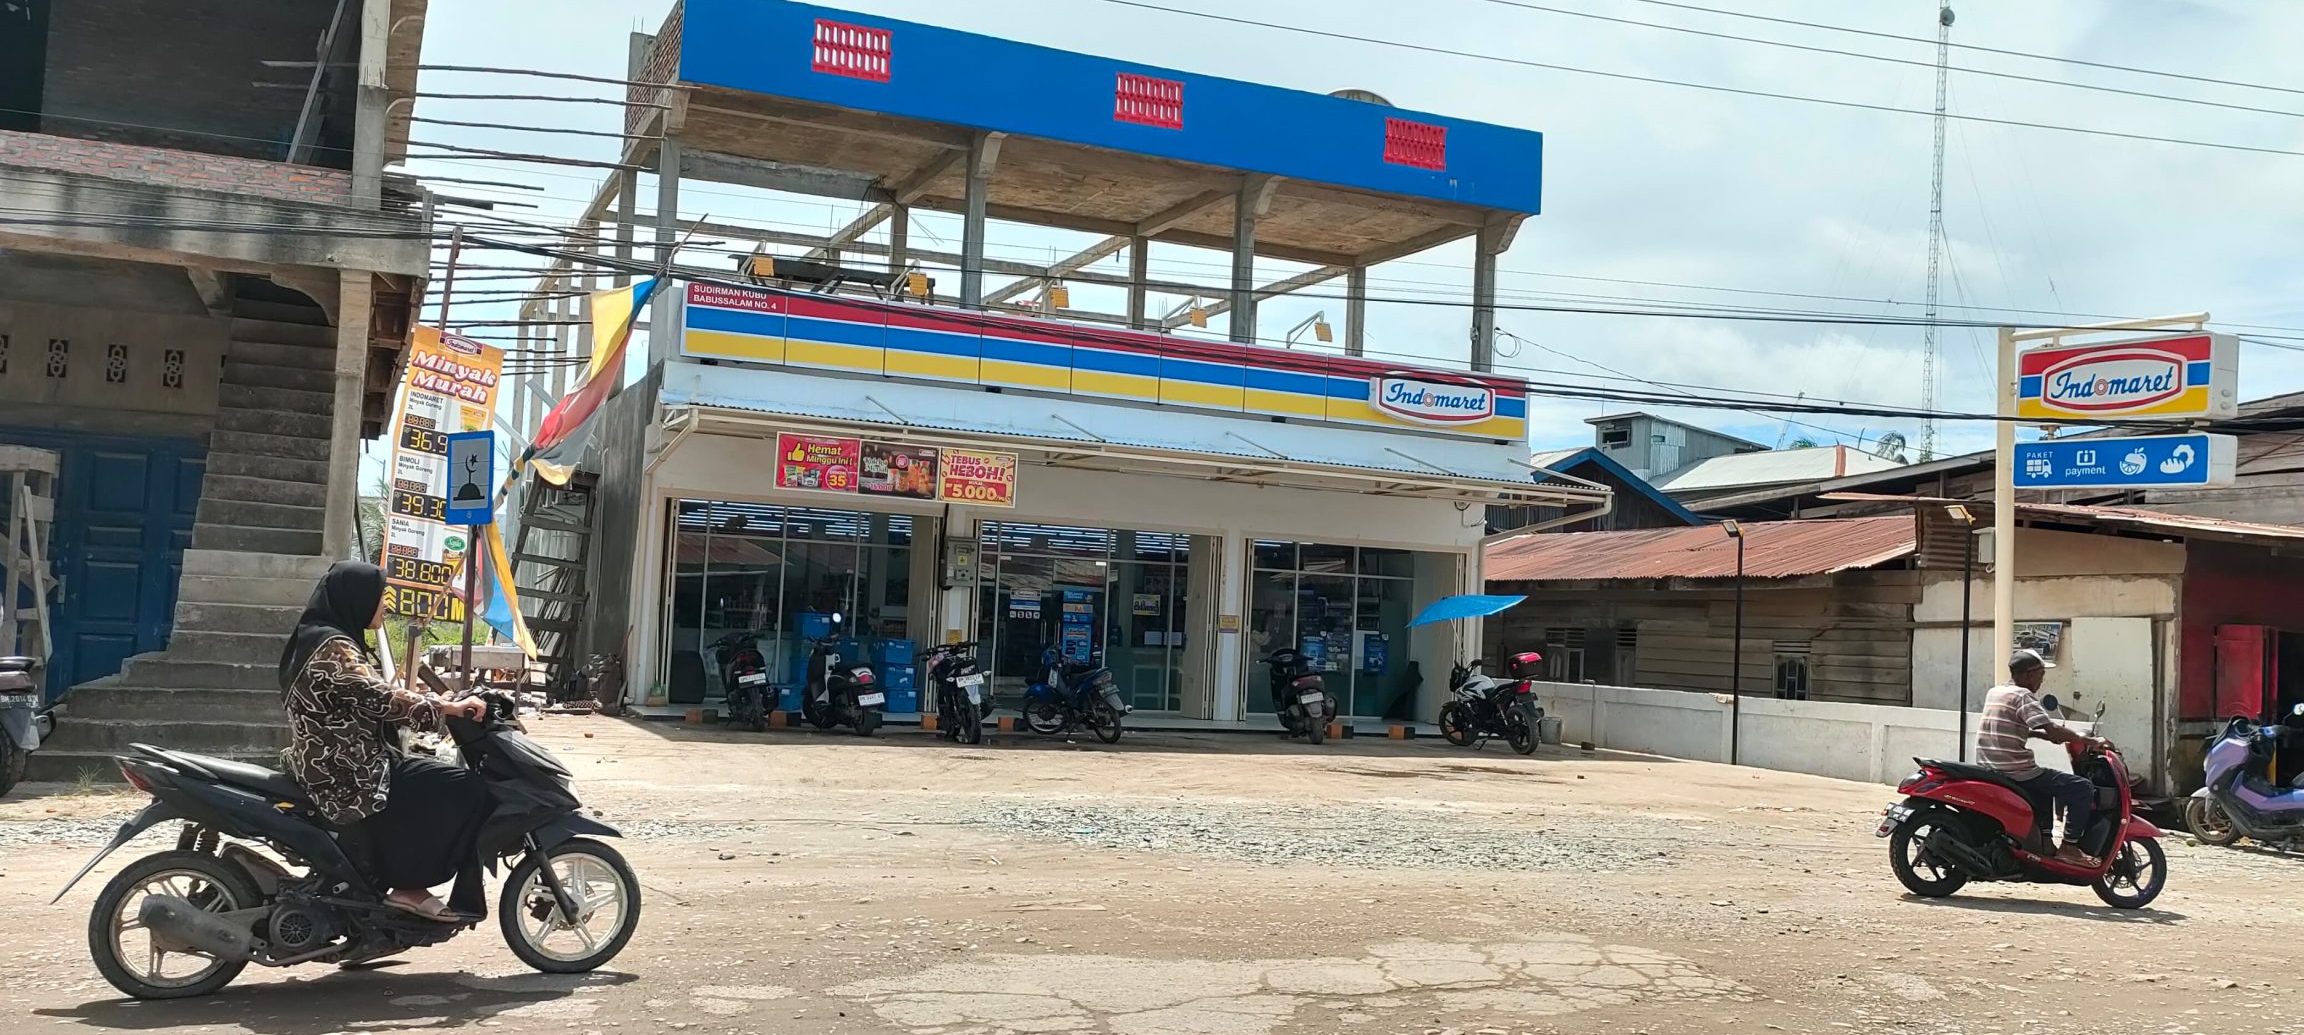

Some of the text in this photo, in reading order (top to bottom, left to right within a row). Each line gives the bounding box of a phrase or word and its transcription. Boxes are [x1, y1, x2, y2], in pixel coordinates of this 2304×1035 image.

[693, 284, 741, 297] SUDIRMAN
[693, 294, 777, 310] BABUSSALAM NO. 4
[412, 350, 497, 387] Minyak
[412, 371, 487, 404] Murah
[2050, 365, 2175, 400] Indomaret
[409, 397, 425, 407] Minyak
[410, 391, 444, 404] INDOMARET
[1385, 382, 1486, 410] Indomaret
[807, 443, 843, 456] Hemat
[2026, 451, 2054, 460] PAKET
[398, 461, 415, 470] Minyak
[399, 455, 420, 466] BIMOLI
[806, 455, 838, 466] Minggu
[951, 454, 982, 465] TEBUS
[949, 464, 1006, 481] HEBOH!
[2064, 465, 2107, 479] payment
[829, 474, 847, 488] 35
[391, 518, 410, 528] SANIA
[391, 524, 425, 537] Minyak Goreng
[395, 558, 452, 585] 38.800
